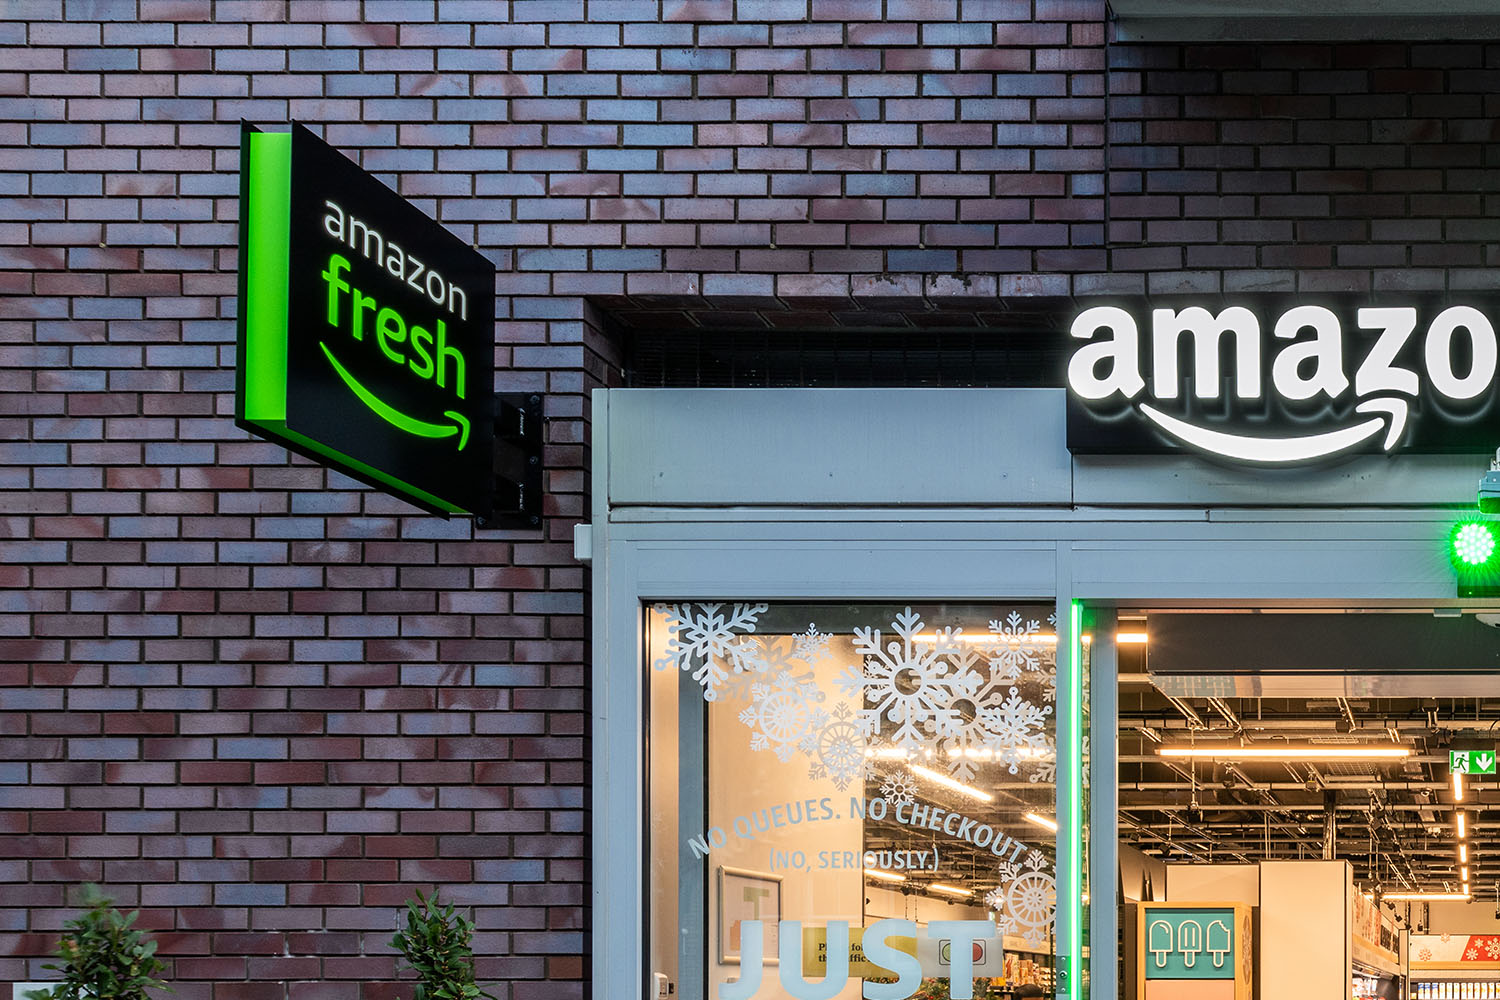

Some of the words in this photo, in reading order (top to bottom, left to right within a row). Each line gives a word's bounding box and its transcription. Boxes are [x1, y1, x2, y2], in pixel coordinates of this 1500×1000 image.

[322, 200, 468, 321] amazon
[321, 254, 467, 400] fresh
[687, 827, 727, 860] NO
[733, 798, 841, 840] QUEUES.
[850, 797, 887, 821] NO
[895, 801, 1028, 869] CHECKOUT.
[769, 848, 811, 872] (NO,
[818, 847, 939, 872] SERIOUSLY.)
[719, 919, 997, 1000] JUST
